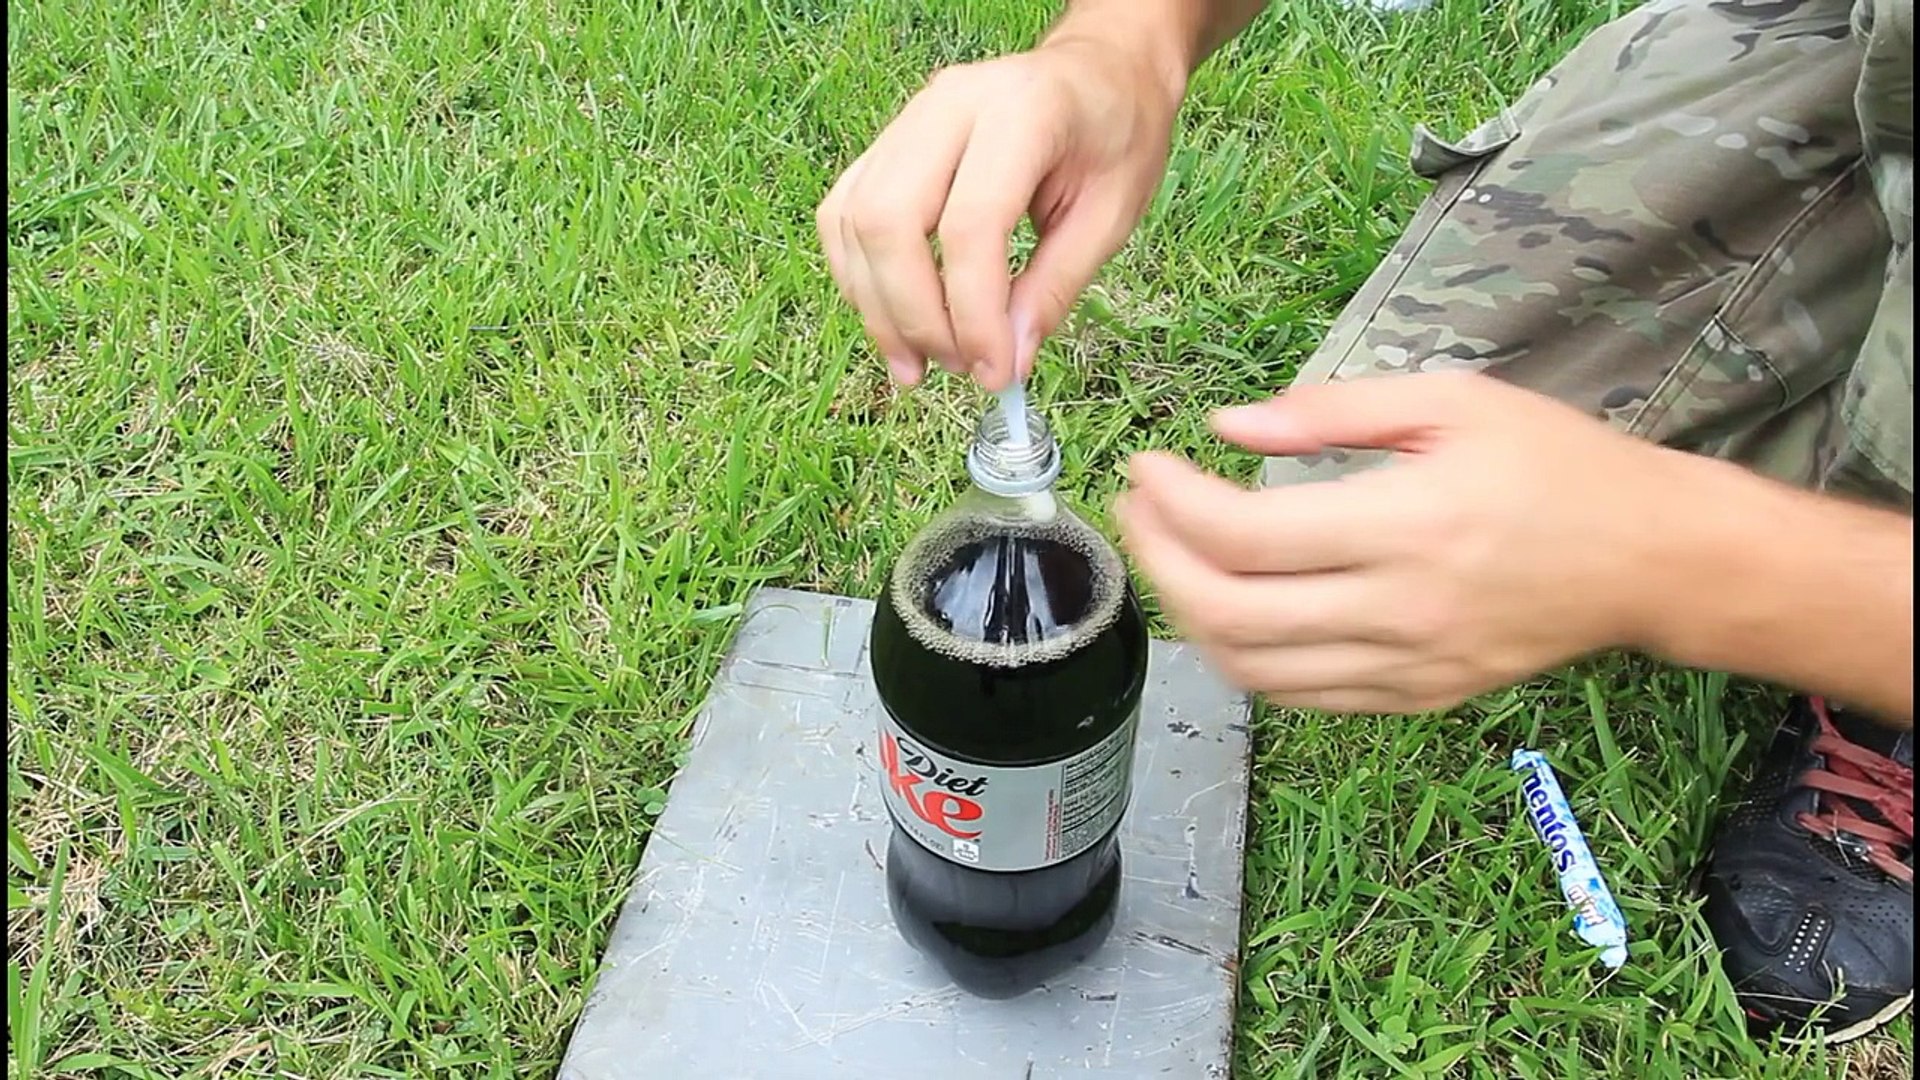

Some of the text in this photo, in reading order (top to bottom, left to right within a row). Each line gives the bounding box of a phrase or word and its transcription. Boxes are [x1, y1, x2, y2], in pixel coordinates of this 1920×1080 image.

[879, 728, 983, 839] ke
[897, 736, 989, 796] Diet
[1519, 760, 1577, 873] mentos
